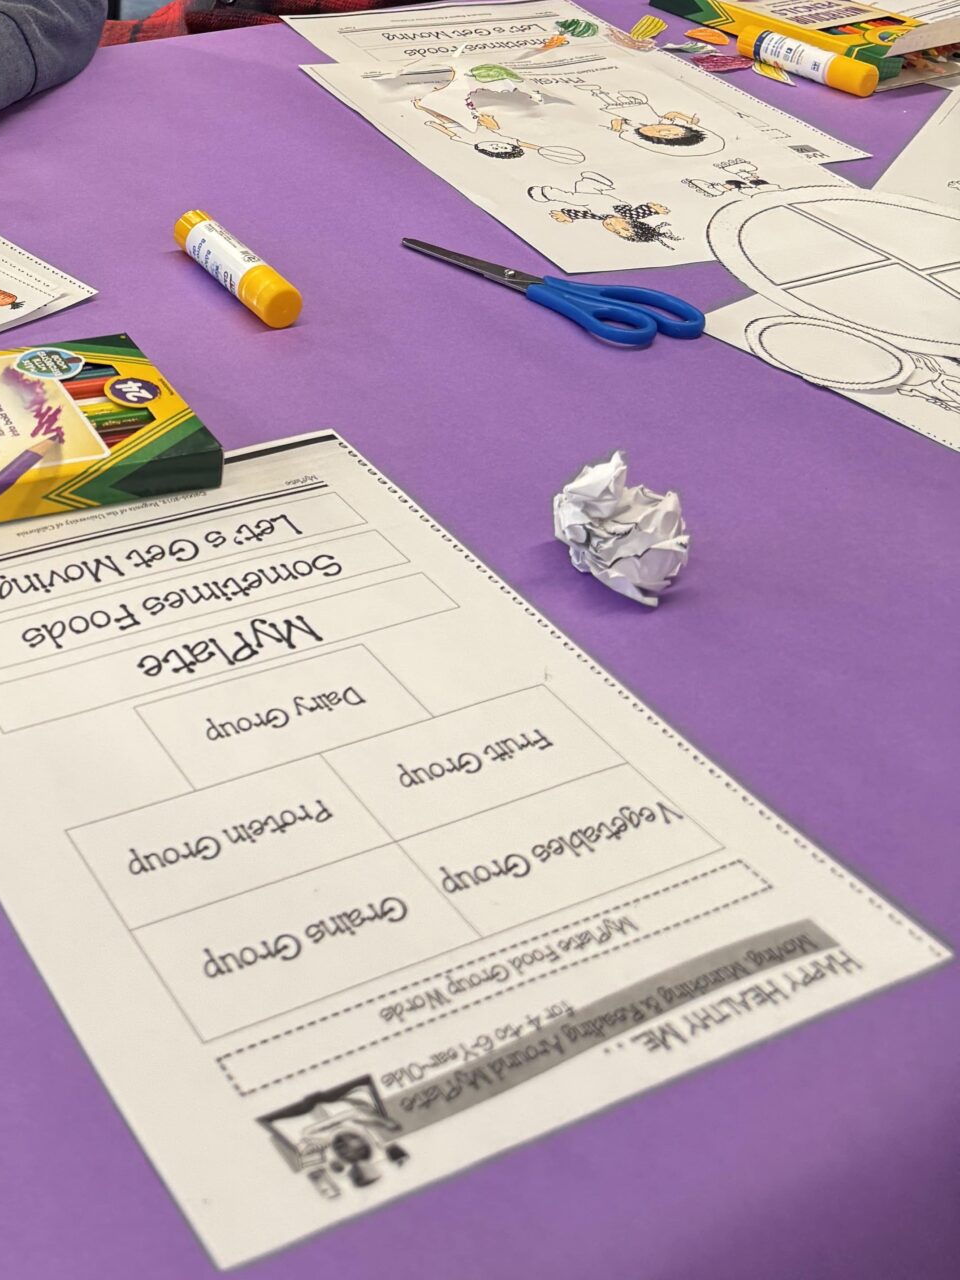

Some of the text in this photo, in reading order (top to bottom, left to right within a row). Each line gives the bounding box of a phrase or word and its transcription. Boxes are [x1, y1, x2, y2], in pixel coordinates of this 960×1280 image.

[382, 31, 452, 43] Moving
[452, 28, 491, 39] Get
[115, 379, 152, 401] 24
[126, 536, 200, 567] Get
[205, 513, 303, 549] Let's
[21, 553, 343, 650] Sometimes Foods
[137, 615, 324, 678] MyPlate
[205, 686, 366, 742] Dairy Group
[399, 728, 554, 789] Fruit Group
[127, 799, 333, 877] Protein Group
[441, 800, 684, 894] Vegetables Group
[203, 897, 408, 979] Grains Group
[380, 916, 639, 1023] MyPlate Food Group Words
[781, 948, 863, 992] HAPPY
[681, 979, 790, 1036] HEALTHY
[491, 1033, 564, 1080] Around
